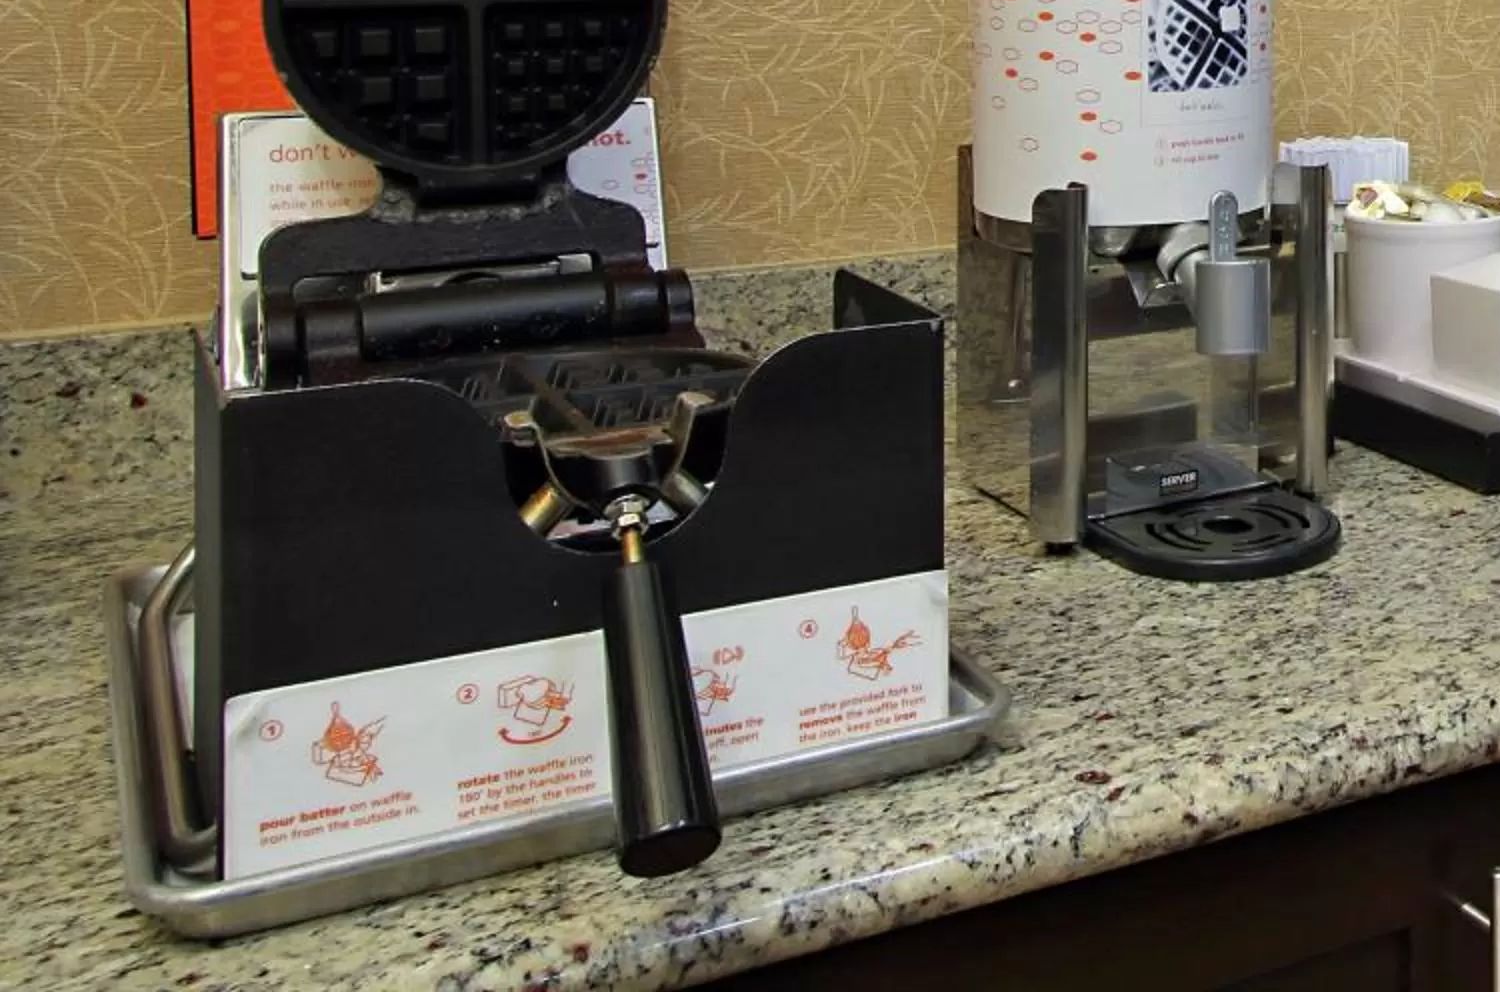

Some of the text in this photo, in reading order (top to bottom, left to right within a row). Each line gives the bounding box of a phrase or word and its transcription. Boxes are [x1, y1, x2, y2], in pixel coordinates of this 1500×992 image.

[269, 143, 331, 163] don't
[703, 720, 744, 737] inutes
[457, 771, 501, 790] rotate
[259, 814, 296, 833] pour
